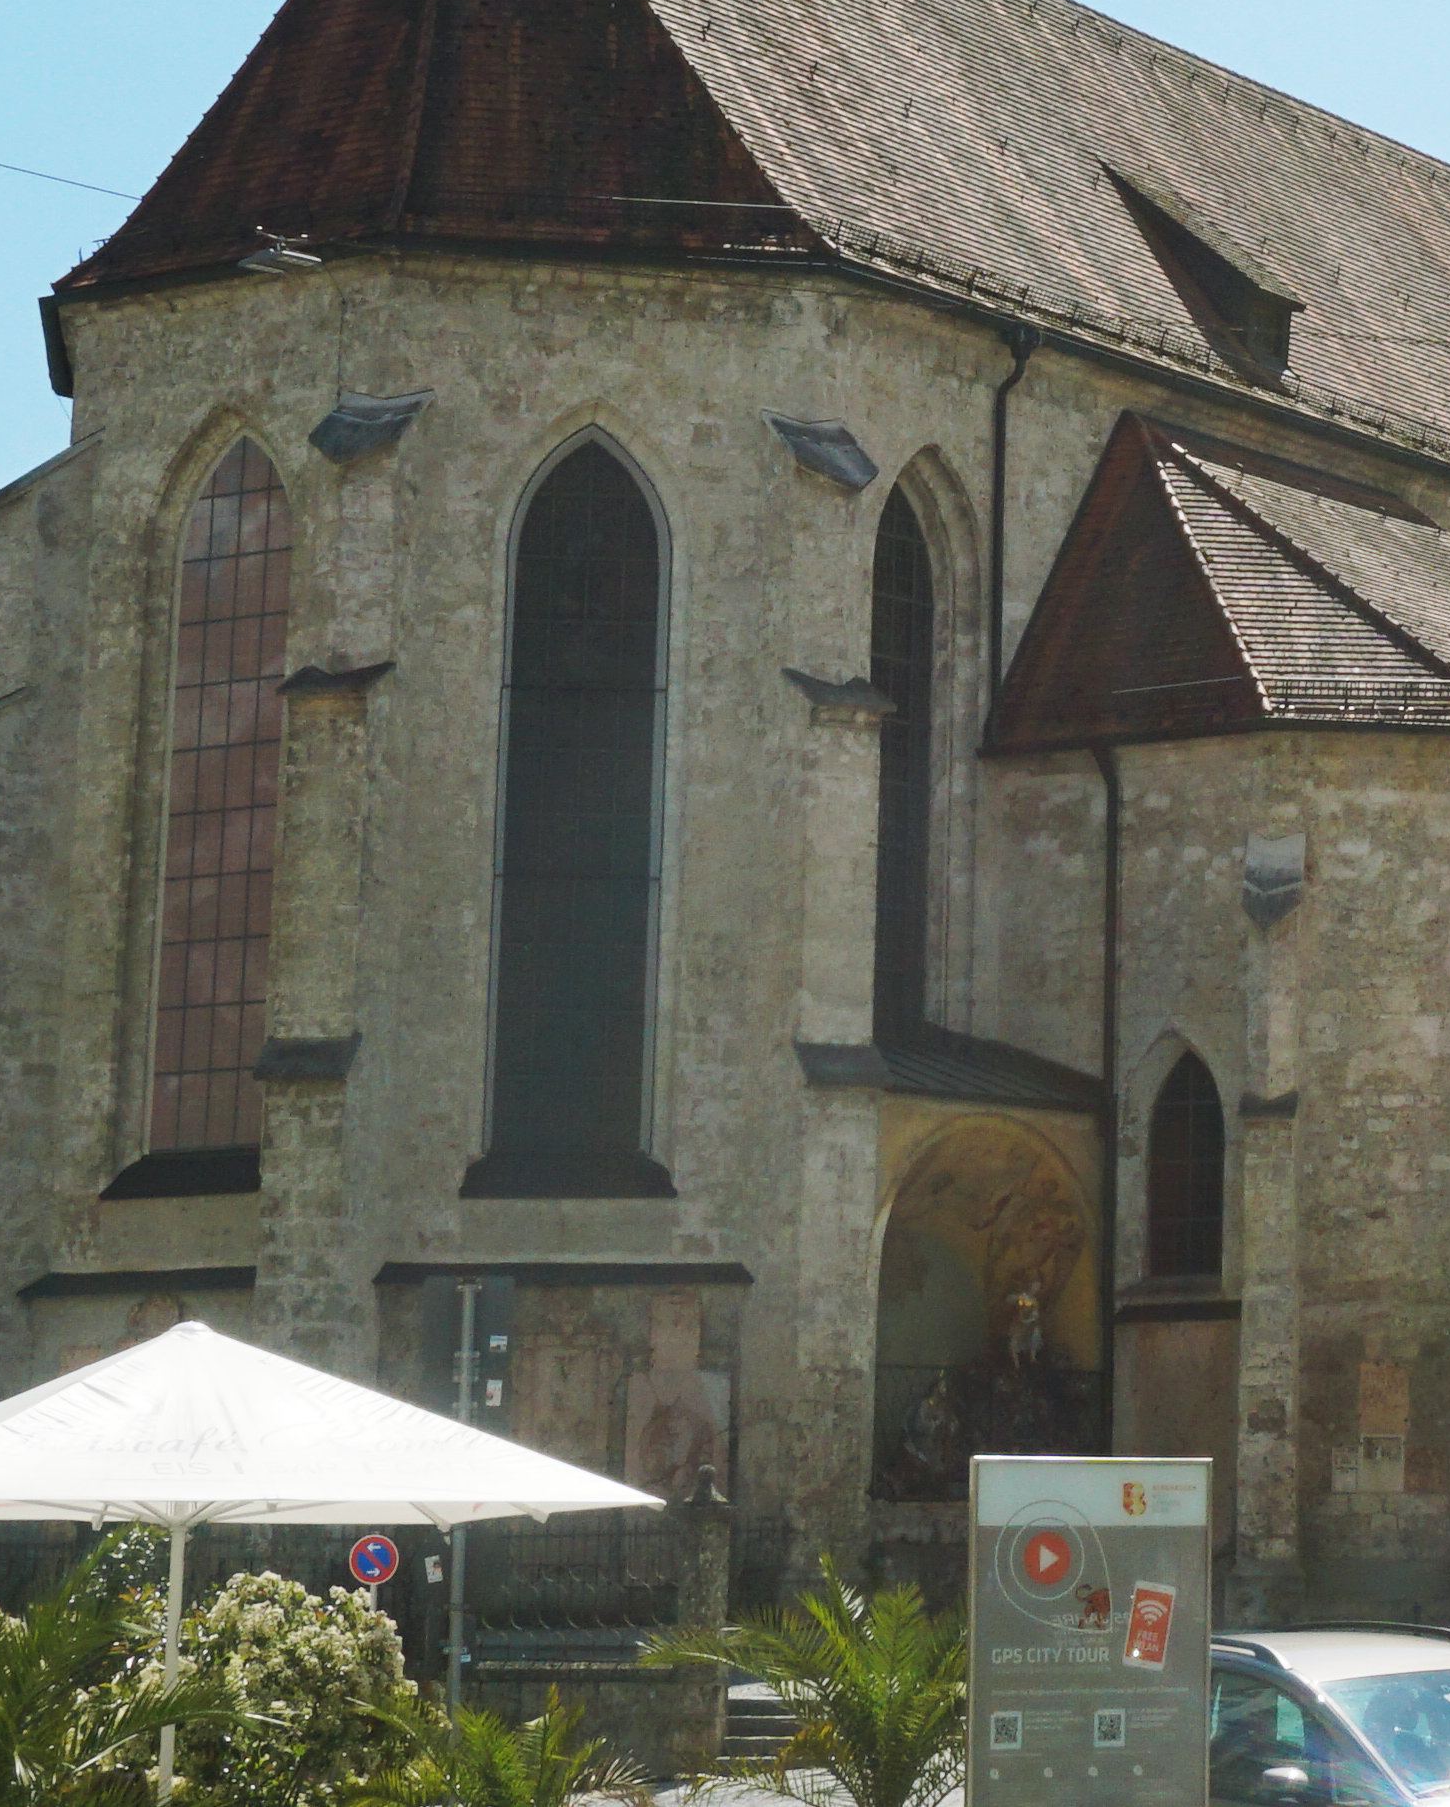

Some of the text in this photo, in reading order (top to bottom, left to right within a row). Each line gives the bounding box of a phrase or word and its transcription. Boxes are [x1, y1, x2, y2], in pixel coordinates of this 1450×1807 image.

[991, 1647, 1110, 1664] GPS CITY TOUR
